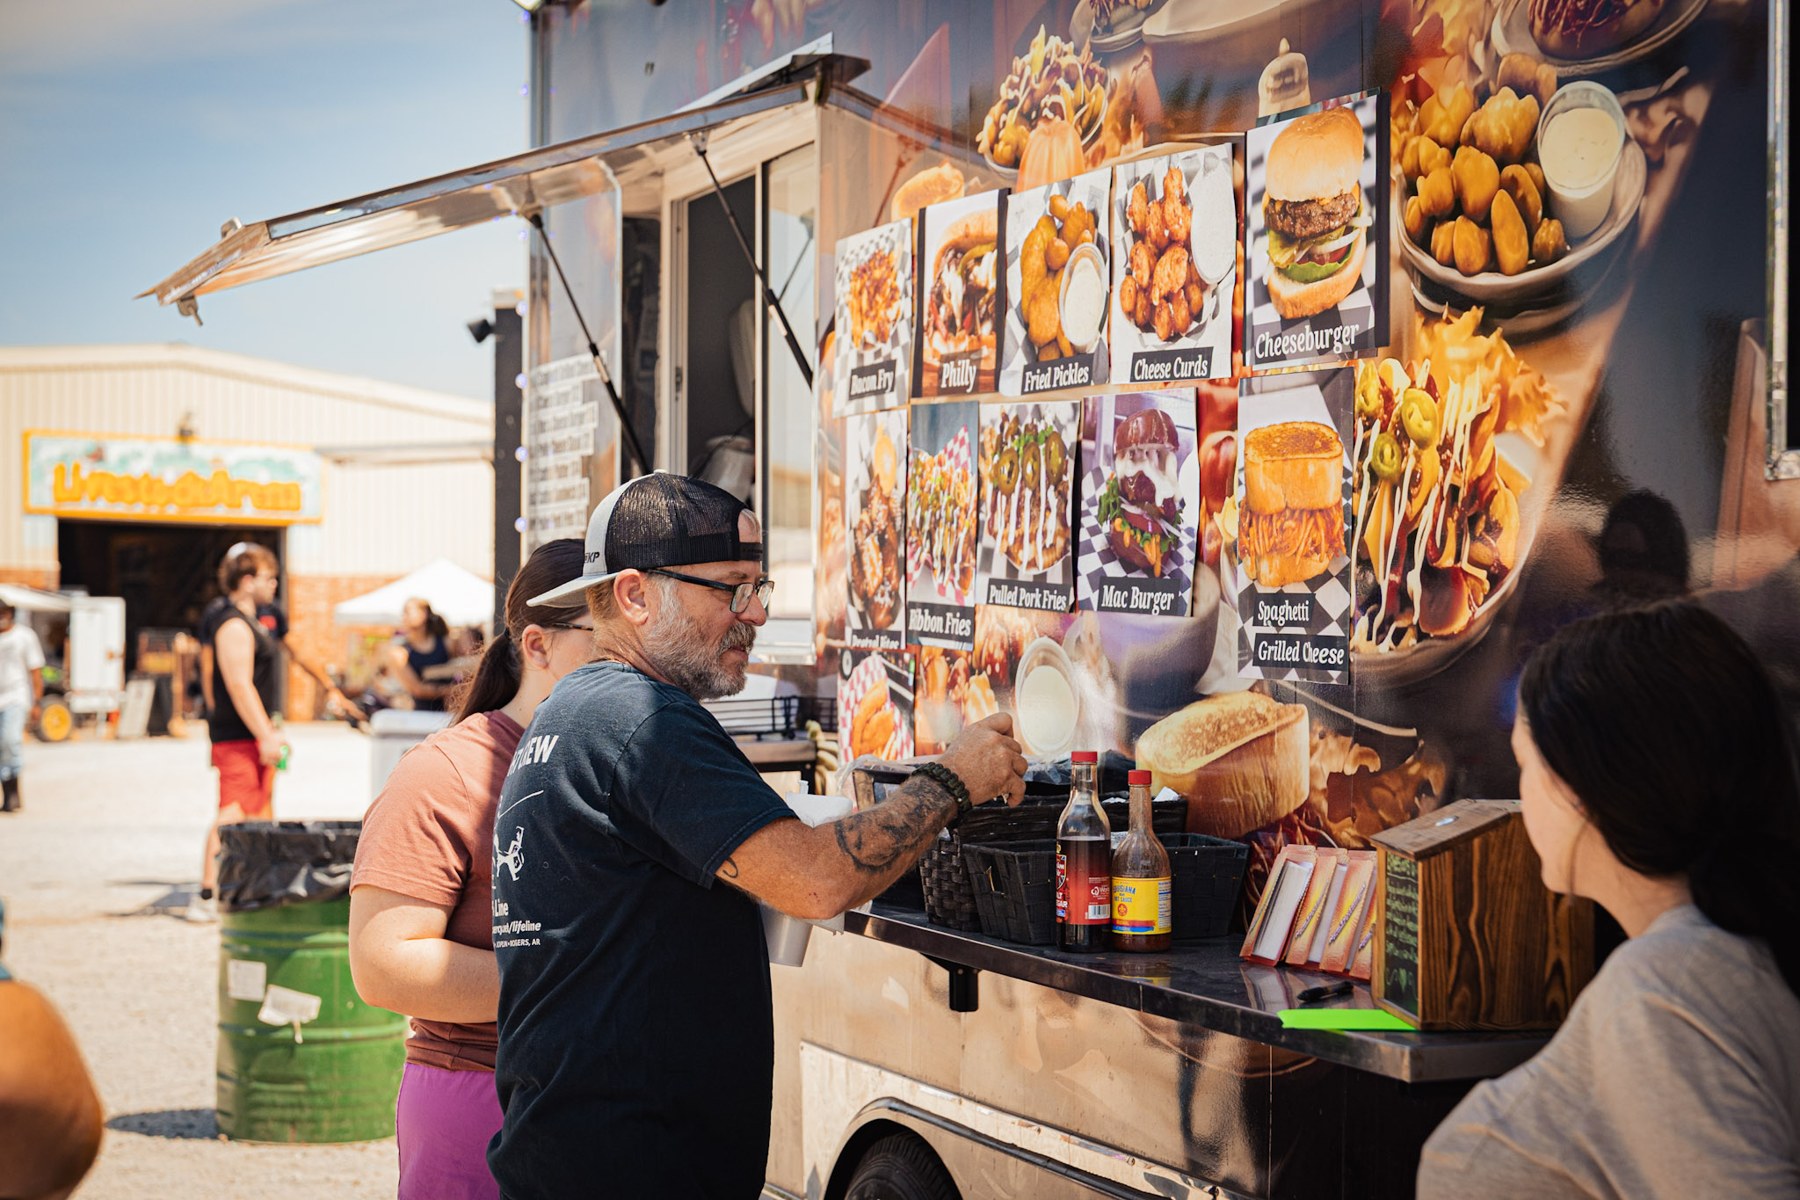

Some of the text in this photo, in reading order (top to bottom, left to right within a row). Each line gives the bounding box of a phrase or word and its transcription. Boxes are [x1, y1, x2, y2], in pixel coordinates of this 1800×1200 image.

[1255, 322, 1360, 359] Cheeseburger
[877, 368, 894, 393] Fry
[940, 358, 977, 393] Philly
[1023, 361, 1090, 392] Fried Pickles
[1134, 355, 1208, 381] Cheese Curds
[988, 584, 1067, 611] Pulled Pork Fries
[1101, 585, 1175, 615] Mac Burger
[908, 607, 971, 637] Ribbon Fries
[1257, 600, 1310, 626] Spaghetti
[1258, 640, 1300, 663] Grilled
[531, 938, 541, 946] AR
